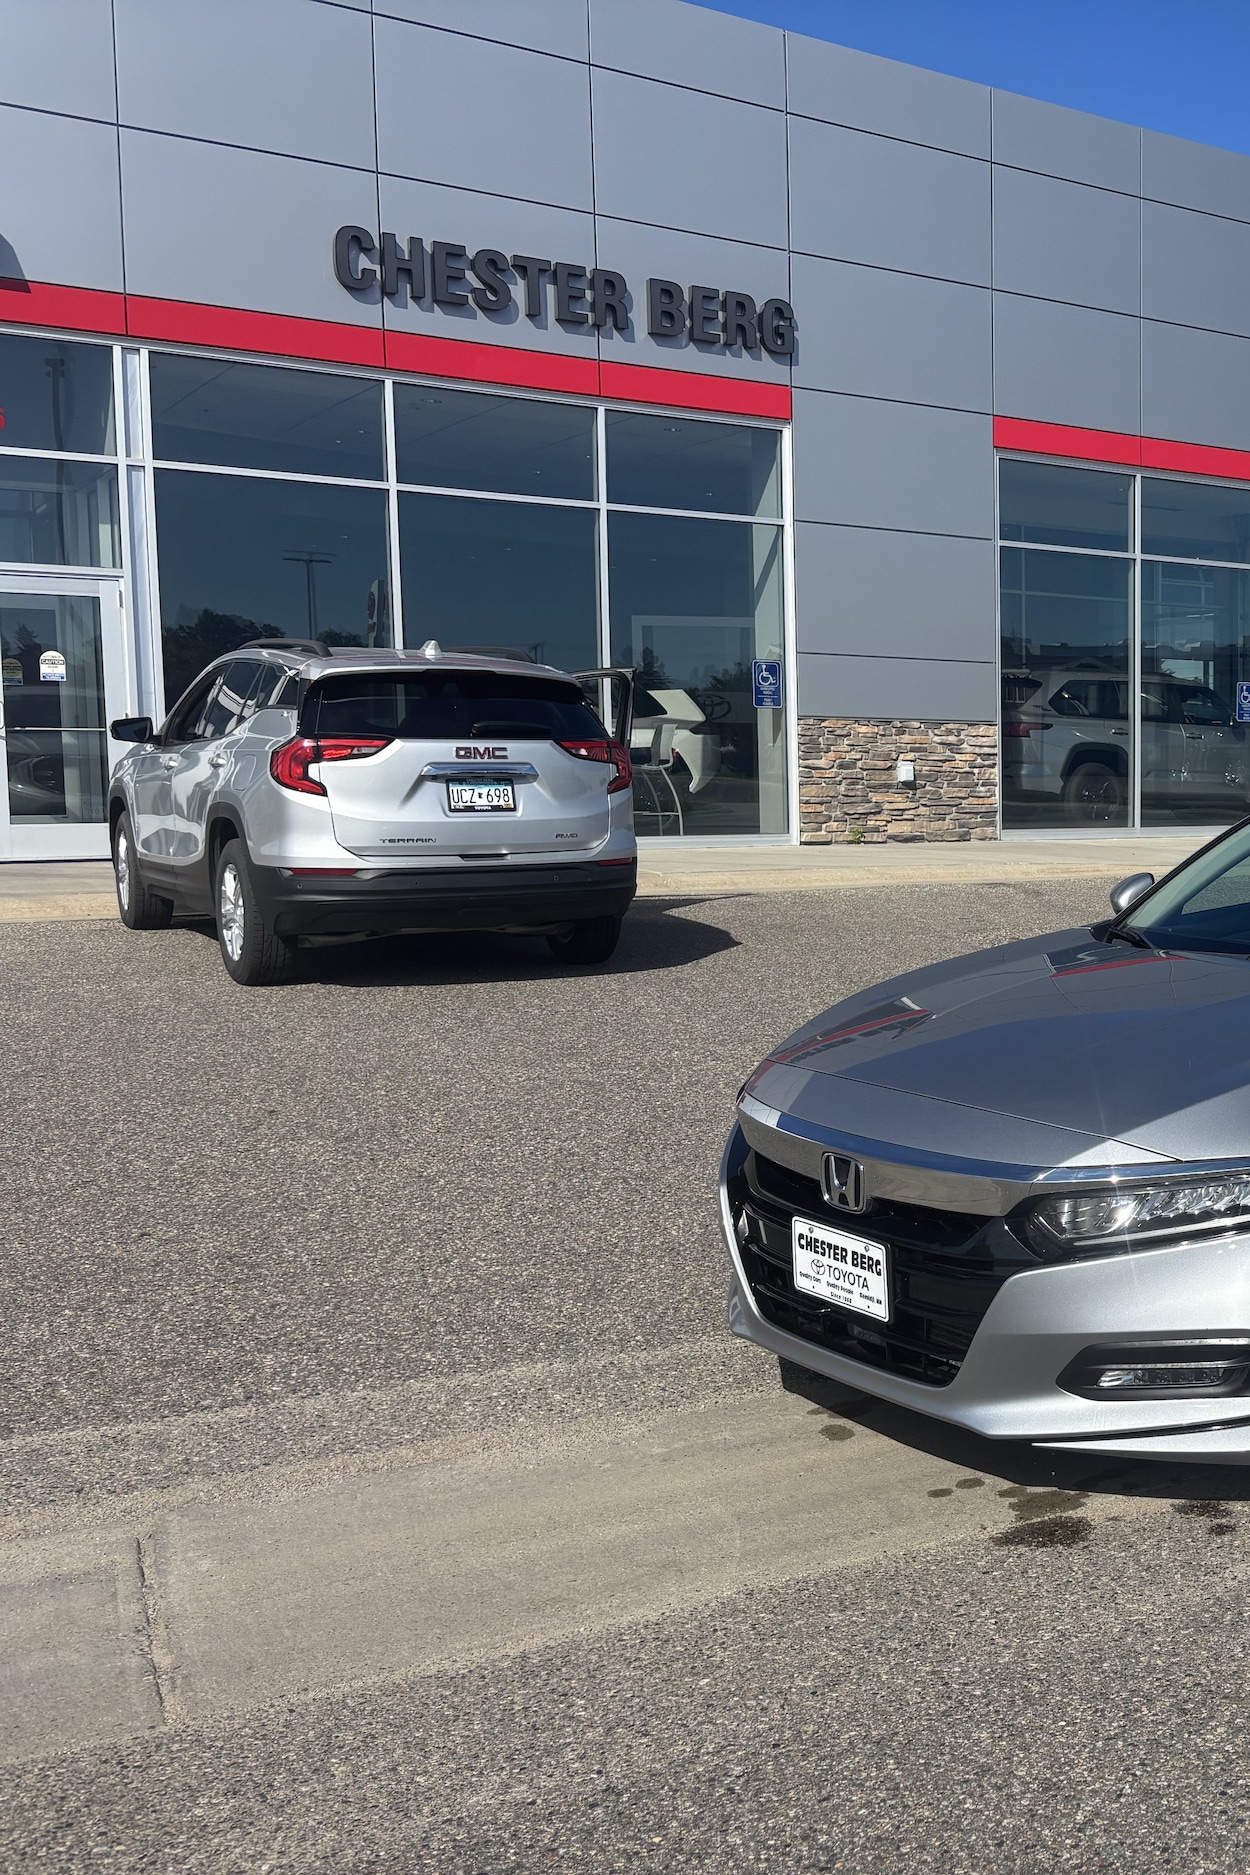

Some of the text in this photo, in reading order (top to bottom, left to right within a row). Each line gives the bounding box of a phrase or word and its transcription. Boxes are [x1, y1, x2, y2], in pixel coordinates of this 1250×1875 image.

[332, 225, 795, 355] CHESTER BERG
[455, 746, 509, 760] GMC
[451, 787, 510, 804] UCZ 698
[797, 1232, 882, 1277] CHESTER BERG
[826, 1264, 870, 1292] TOYOTA
